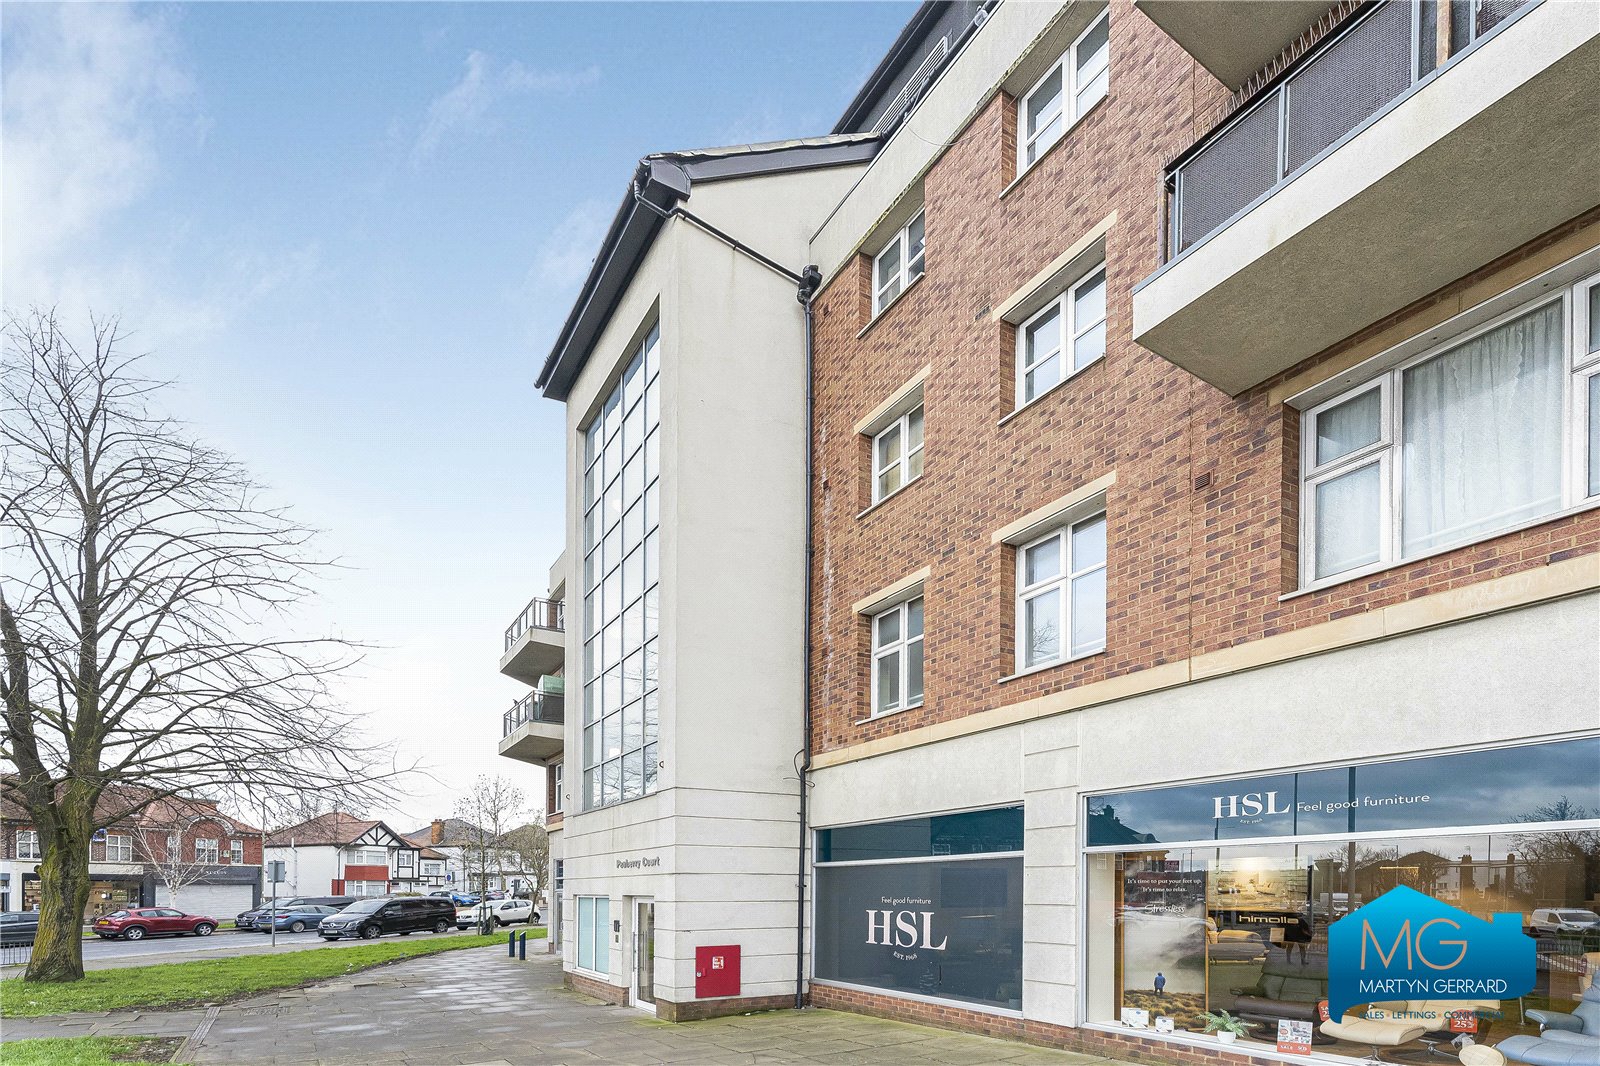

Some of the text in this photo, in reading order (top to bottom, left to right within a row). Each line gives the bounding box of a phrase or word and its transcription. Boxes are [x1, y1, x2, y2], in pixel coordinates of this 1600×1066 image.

[1212, 791, 1291, 819] HSL
[1297, 794, 1430, 813] Feel good furniture
[642, 857, 660, 867] Court
[881, 896, 931, 906] Feel good furniture
[1145, 904, 1186, 913] Stressless
[865, 909, 948, 950] HSL
